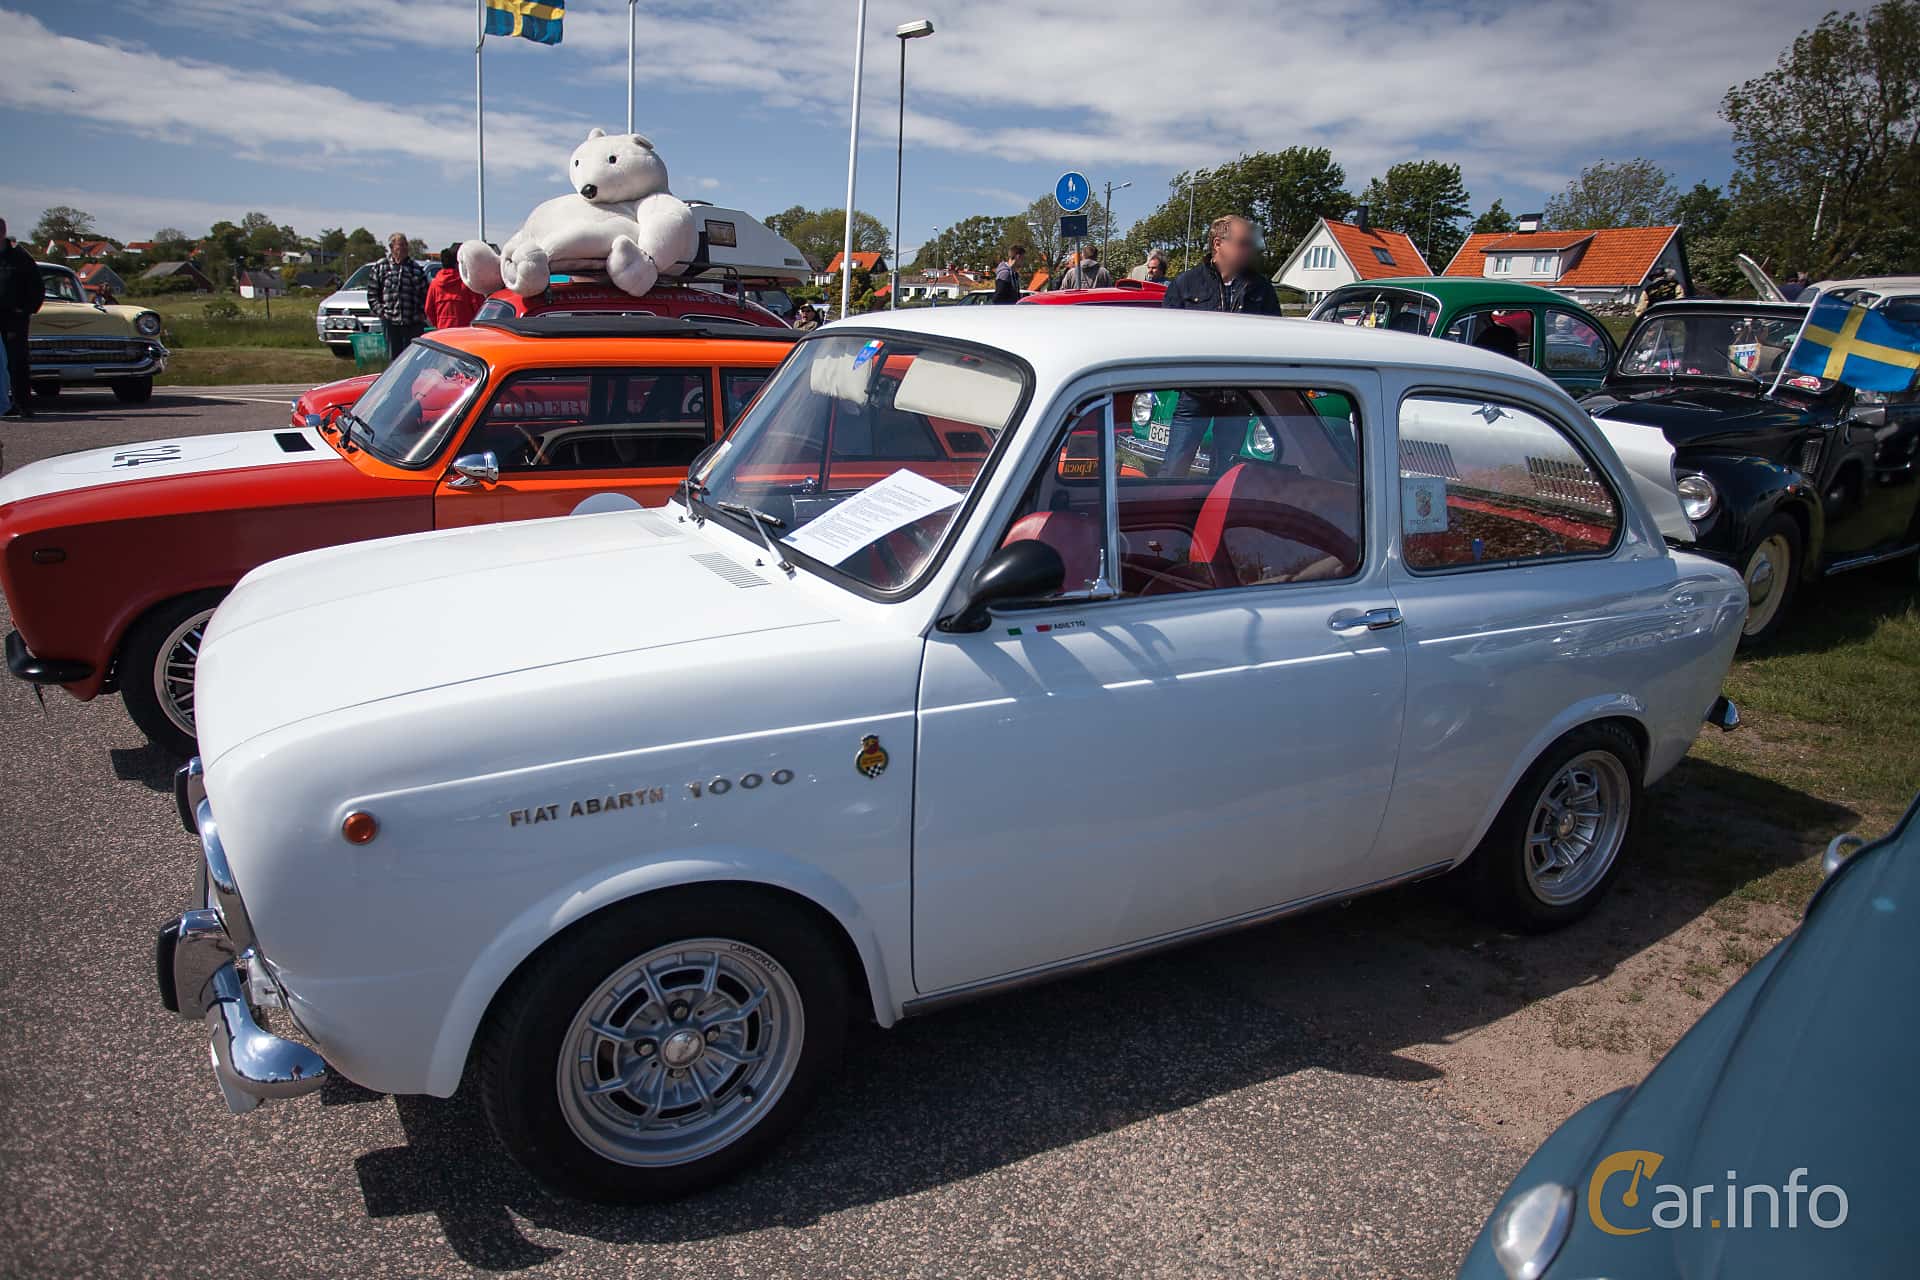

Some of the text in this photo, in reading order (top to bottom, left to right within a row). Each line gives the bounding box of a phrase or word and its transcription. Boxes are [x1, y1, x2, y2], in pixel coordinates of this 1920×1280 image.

[510, 768, 795, 826] FIAT ABARTH 1000
